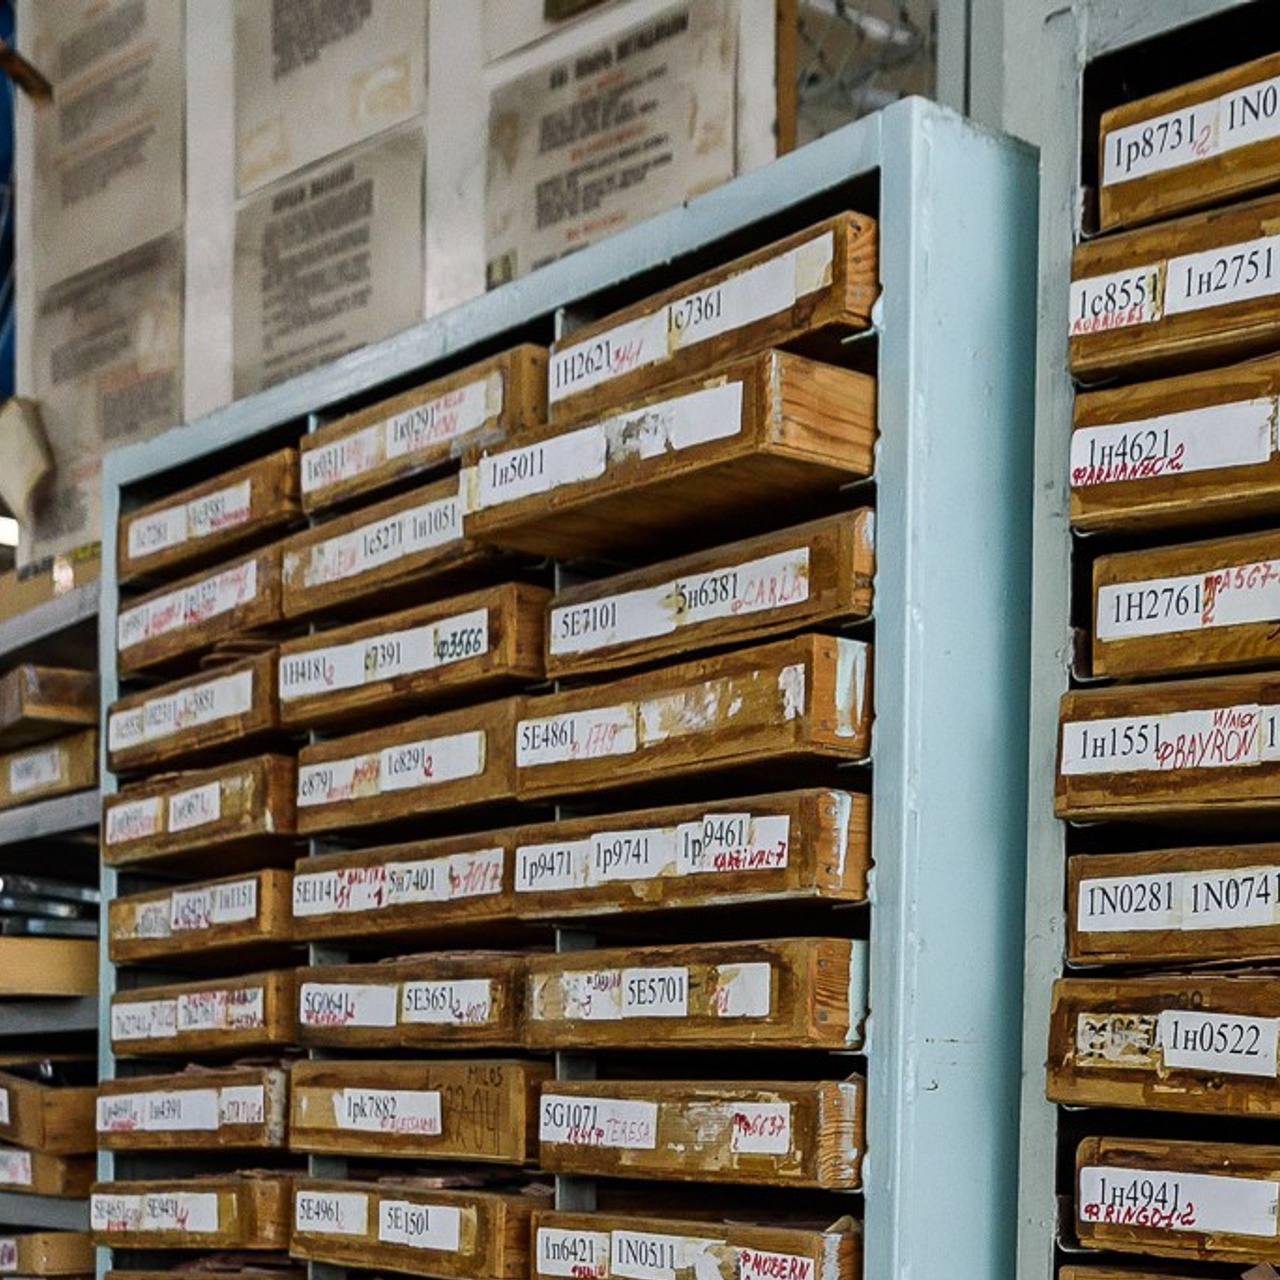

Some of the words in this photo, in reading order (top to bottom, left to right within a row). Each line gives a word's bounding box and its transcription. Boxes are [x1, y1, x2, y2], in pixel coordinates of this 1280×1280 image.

[1114, 115, 1194, 172] 1p8731
[1081, 273, 1157, 321] 1c8551
[1115, 585, 1199, 622] 1H2761
[522, 721, 576, 750] 5E4861
[1090, 882, 1171, 915] 1N0281
[628, 977, 683, 1005] 5E5701
[544, 1103, 597, 1129] 5G1071
